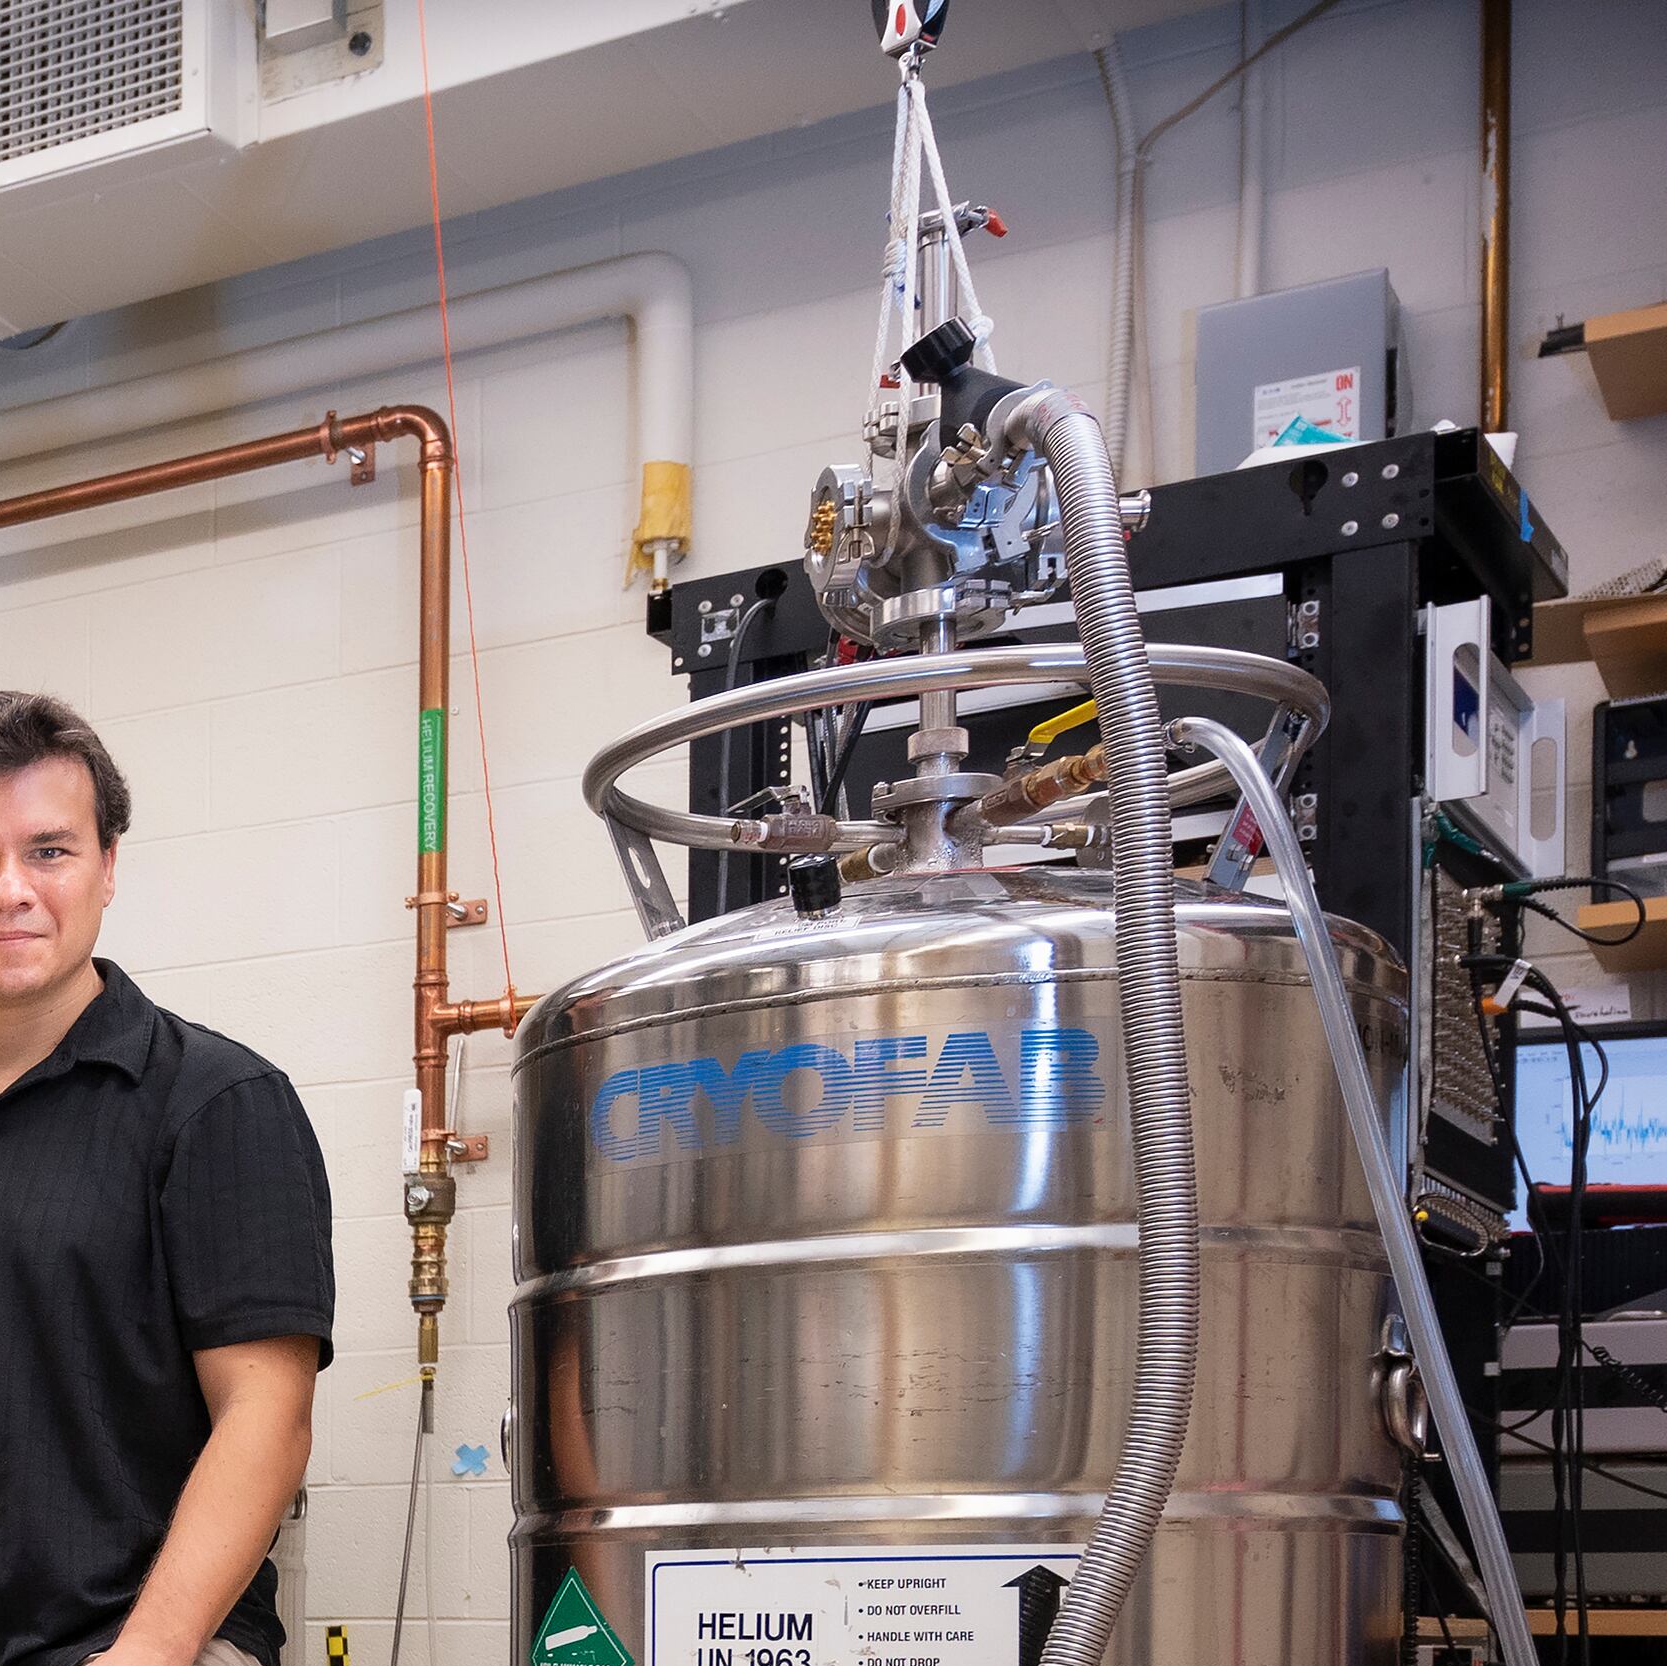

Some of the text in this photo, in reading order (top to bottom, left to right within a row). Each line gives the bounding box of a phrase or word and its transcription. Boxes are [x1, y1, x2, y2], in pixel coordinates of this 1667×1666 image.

[421, 719, 437, 850] HELIUM RECOVERY
[591, 1028, 1106, 1161] CRYOFAB
[868, 1578, 946, 1589] KEEP UPRIGHT
[868, 1605, 961, 1615] DO NOT OVERFILL
[698, 1613, 813, 1641] HELIUM
[868, 1631, 974, 1641] HANDLE WITH CARE
